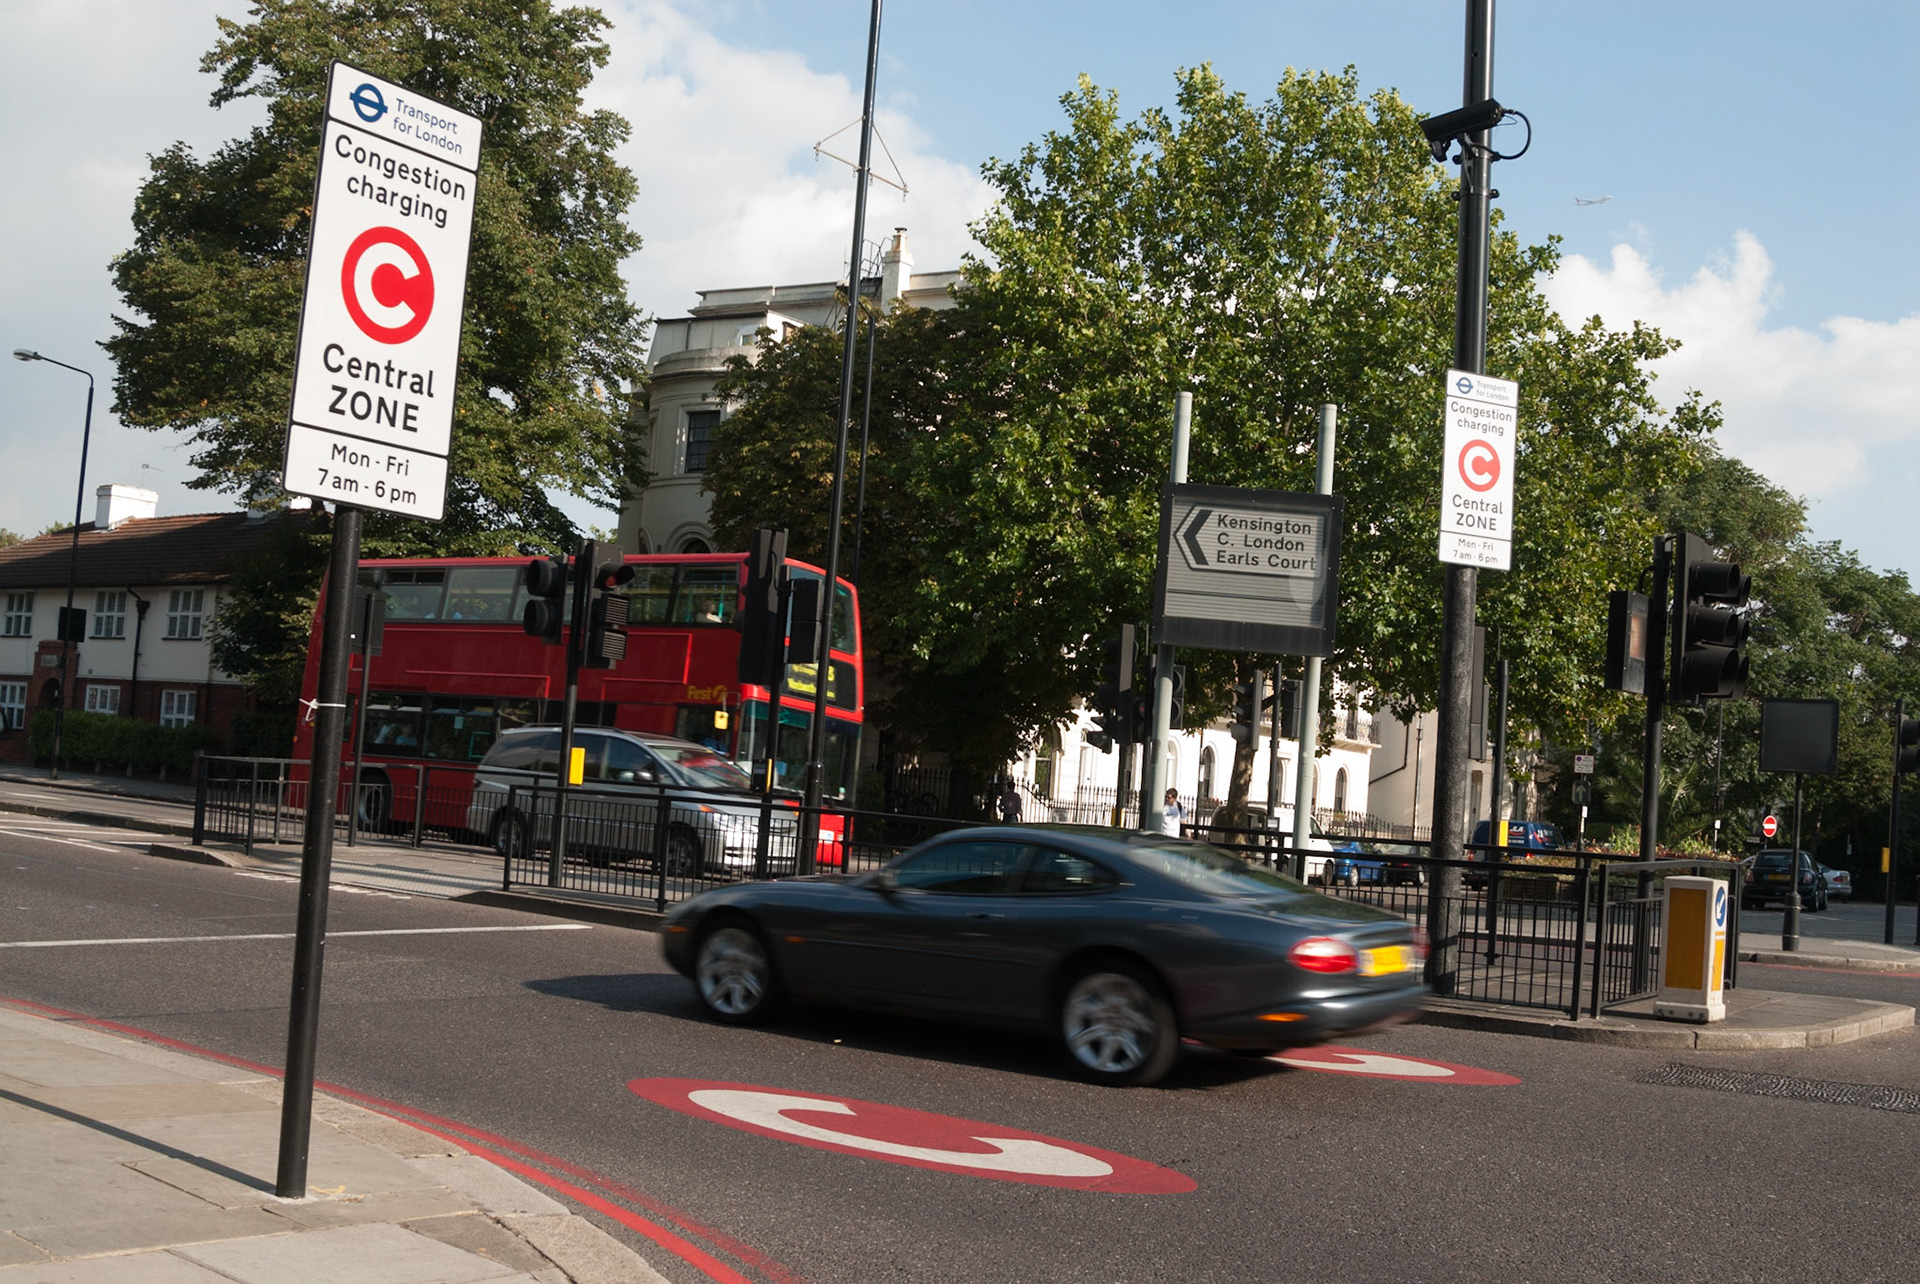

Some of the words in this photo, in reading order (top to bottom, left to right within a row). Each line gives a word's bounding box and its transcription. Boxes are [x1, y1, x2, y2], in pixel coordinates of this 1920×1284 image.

[396, 98, 458, 134] Transport
[393, 117, 412, 135] for
[415, 125, 462, 154] London
[335, 134, 466, 201] Congestion
[347, 175, 448, 229] charging
[353, 241, 421, 329] C
[323, 343, 434, 398] Central
[1476, 389, 1486, 397] for
[1486, 391, 1510, 402] London
[1477, 381, 1506, 393] Transport
[328, 384, 419, 433] ZONE
[1450, 401, 1512, 423] Congestion
[1457, 418, 1505, 437] charging
[331, 443, 370, 468] Mon
[386, 455, 410, 476] Fri
[1463, 446, 1494, 486] C
[1452, 494, 1504, 515] Central
[1217, 514, 1311, 535] Kensington
[1456, 512, 1497, 532] ZONE
[1217, 532, 1234, 547] C.
[1244, 534, 1305, 552] London
[1458, 538, 1476, 548] Mon
[1482, 542, 1494, 551] Fri
[1216, 550, 1259, 566] Earls
[1268, 554, 1316, 571] Court
[687, 685, 711, 700] First
[688, 1089, 1113, 1177] C
